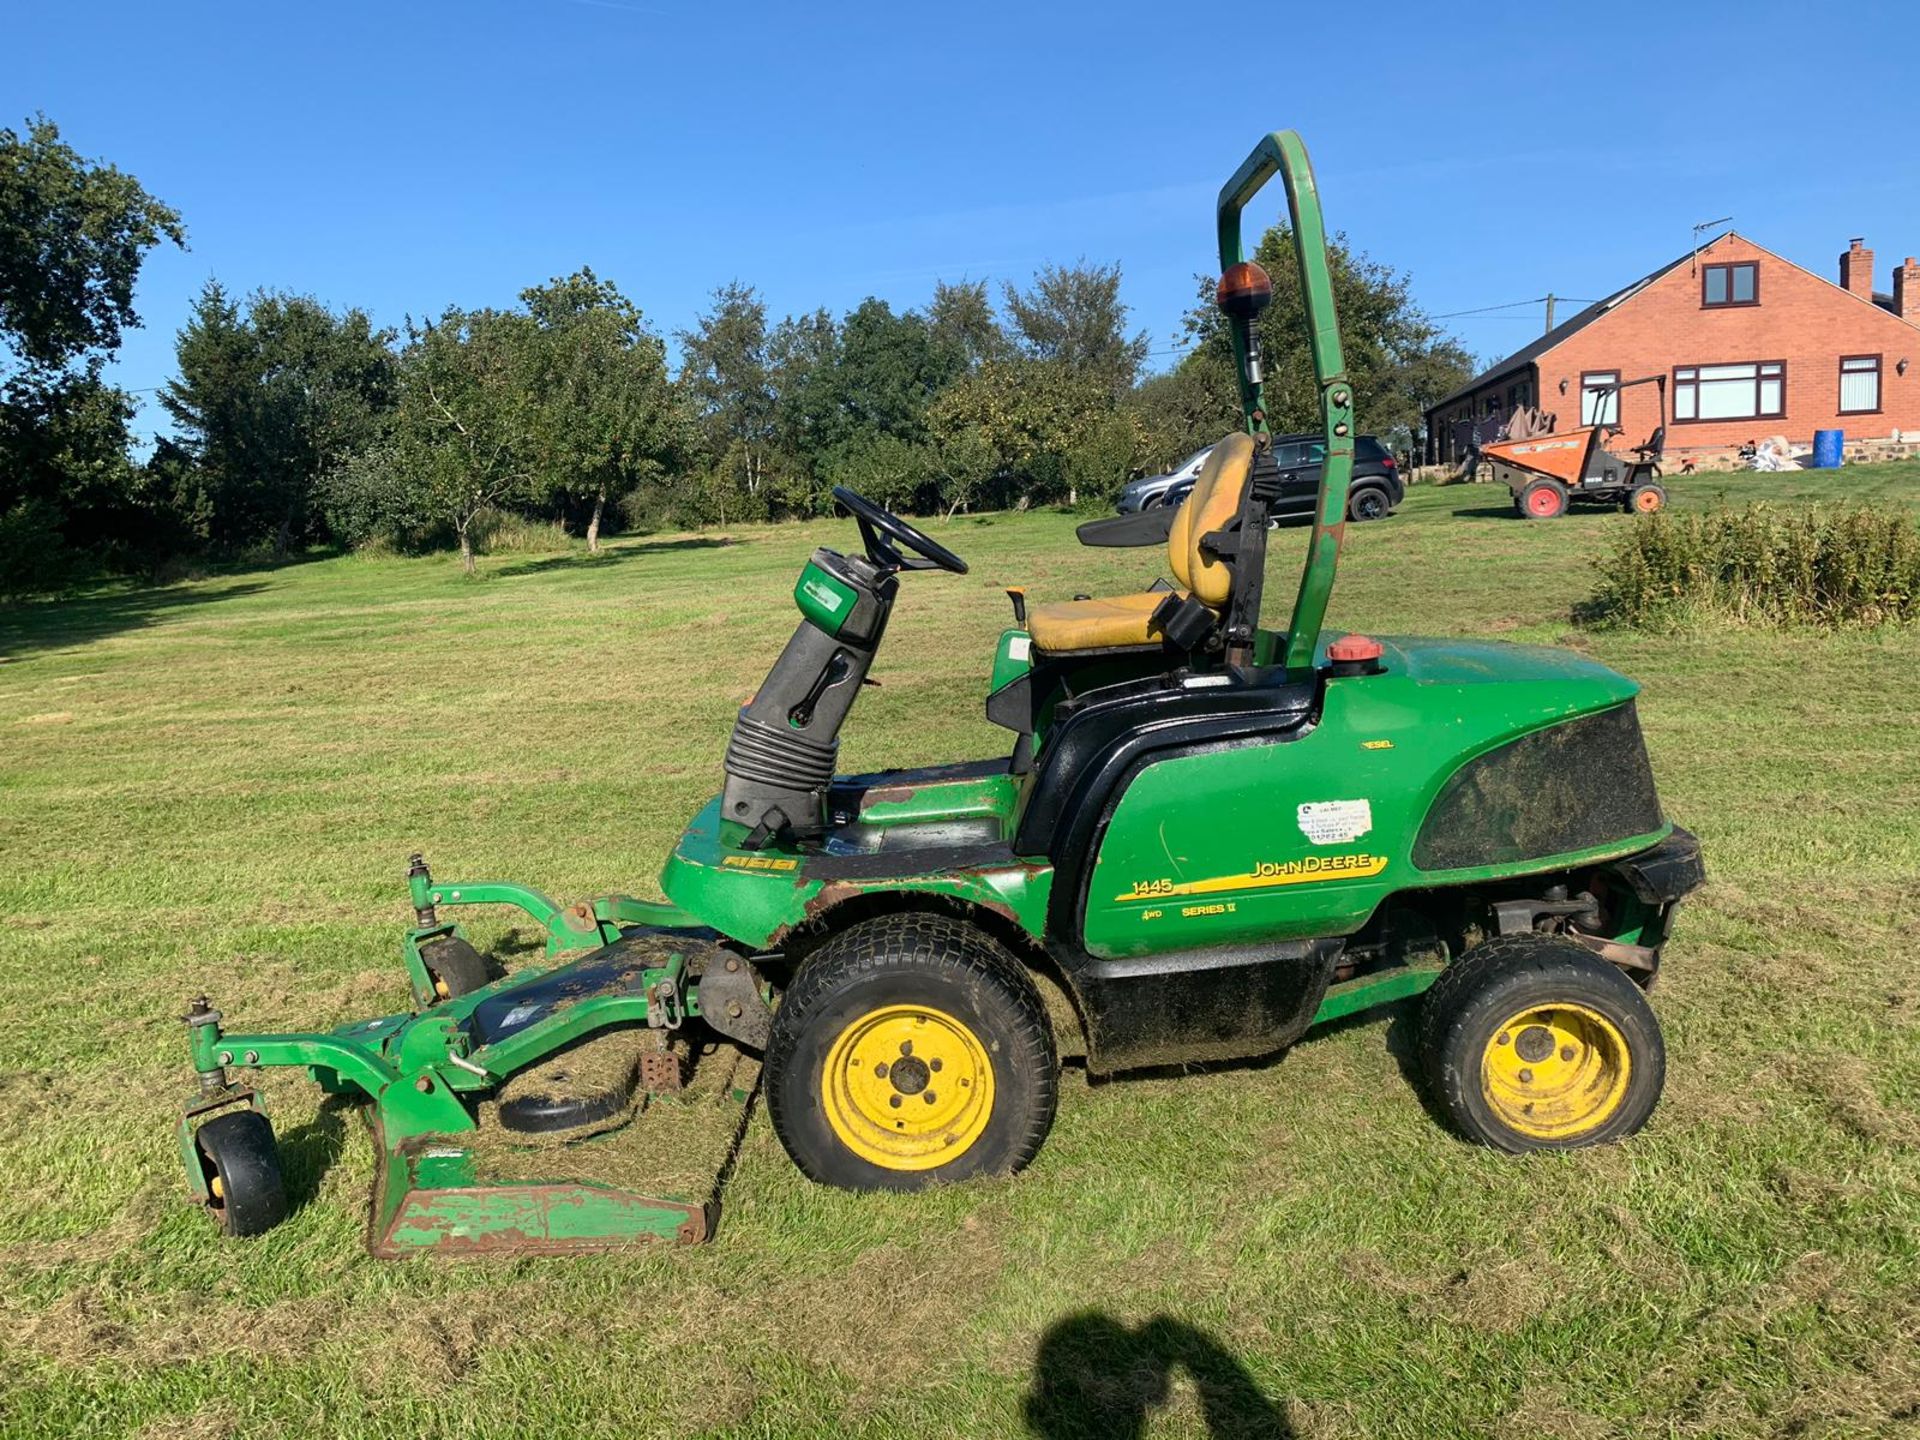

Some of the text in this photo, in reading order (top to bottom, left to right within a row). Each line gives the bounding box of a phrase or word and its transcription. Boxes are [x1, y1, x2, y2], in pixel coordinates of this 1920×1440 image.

[1249, 854, 1371, 877] JOHN DEERE
[1132, 878, 1173, 895] 1445
[1142, 909, 1162, 921] 4WD
[1182, 904, 1226, 917] SERIES
